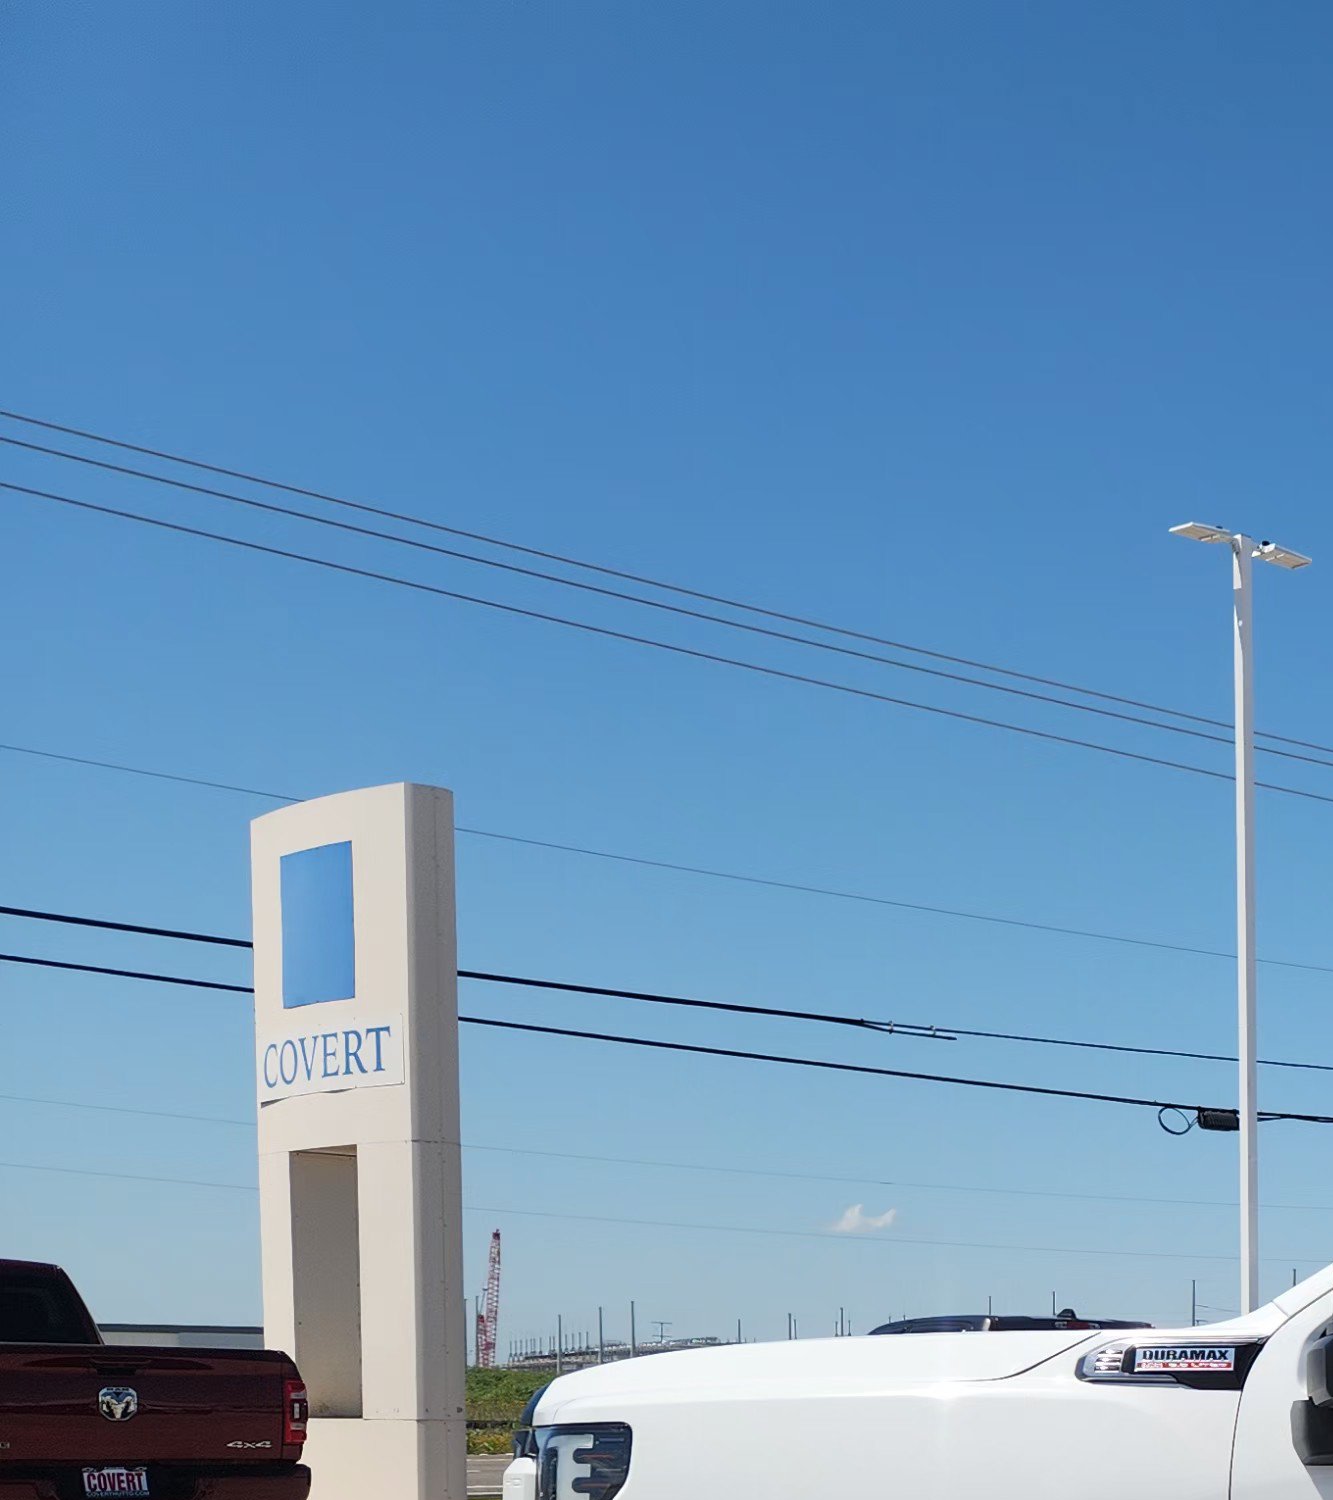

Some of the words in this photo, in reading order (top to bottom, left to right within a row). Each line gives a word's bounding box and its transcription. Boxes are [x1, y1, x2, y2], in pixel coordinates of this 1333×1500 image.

[263, 1026, 391, 1088] COVERT
[1142, 1350, 1228, 1360] DURAMAX
[86, 1471, 143, 1491] COVERT
